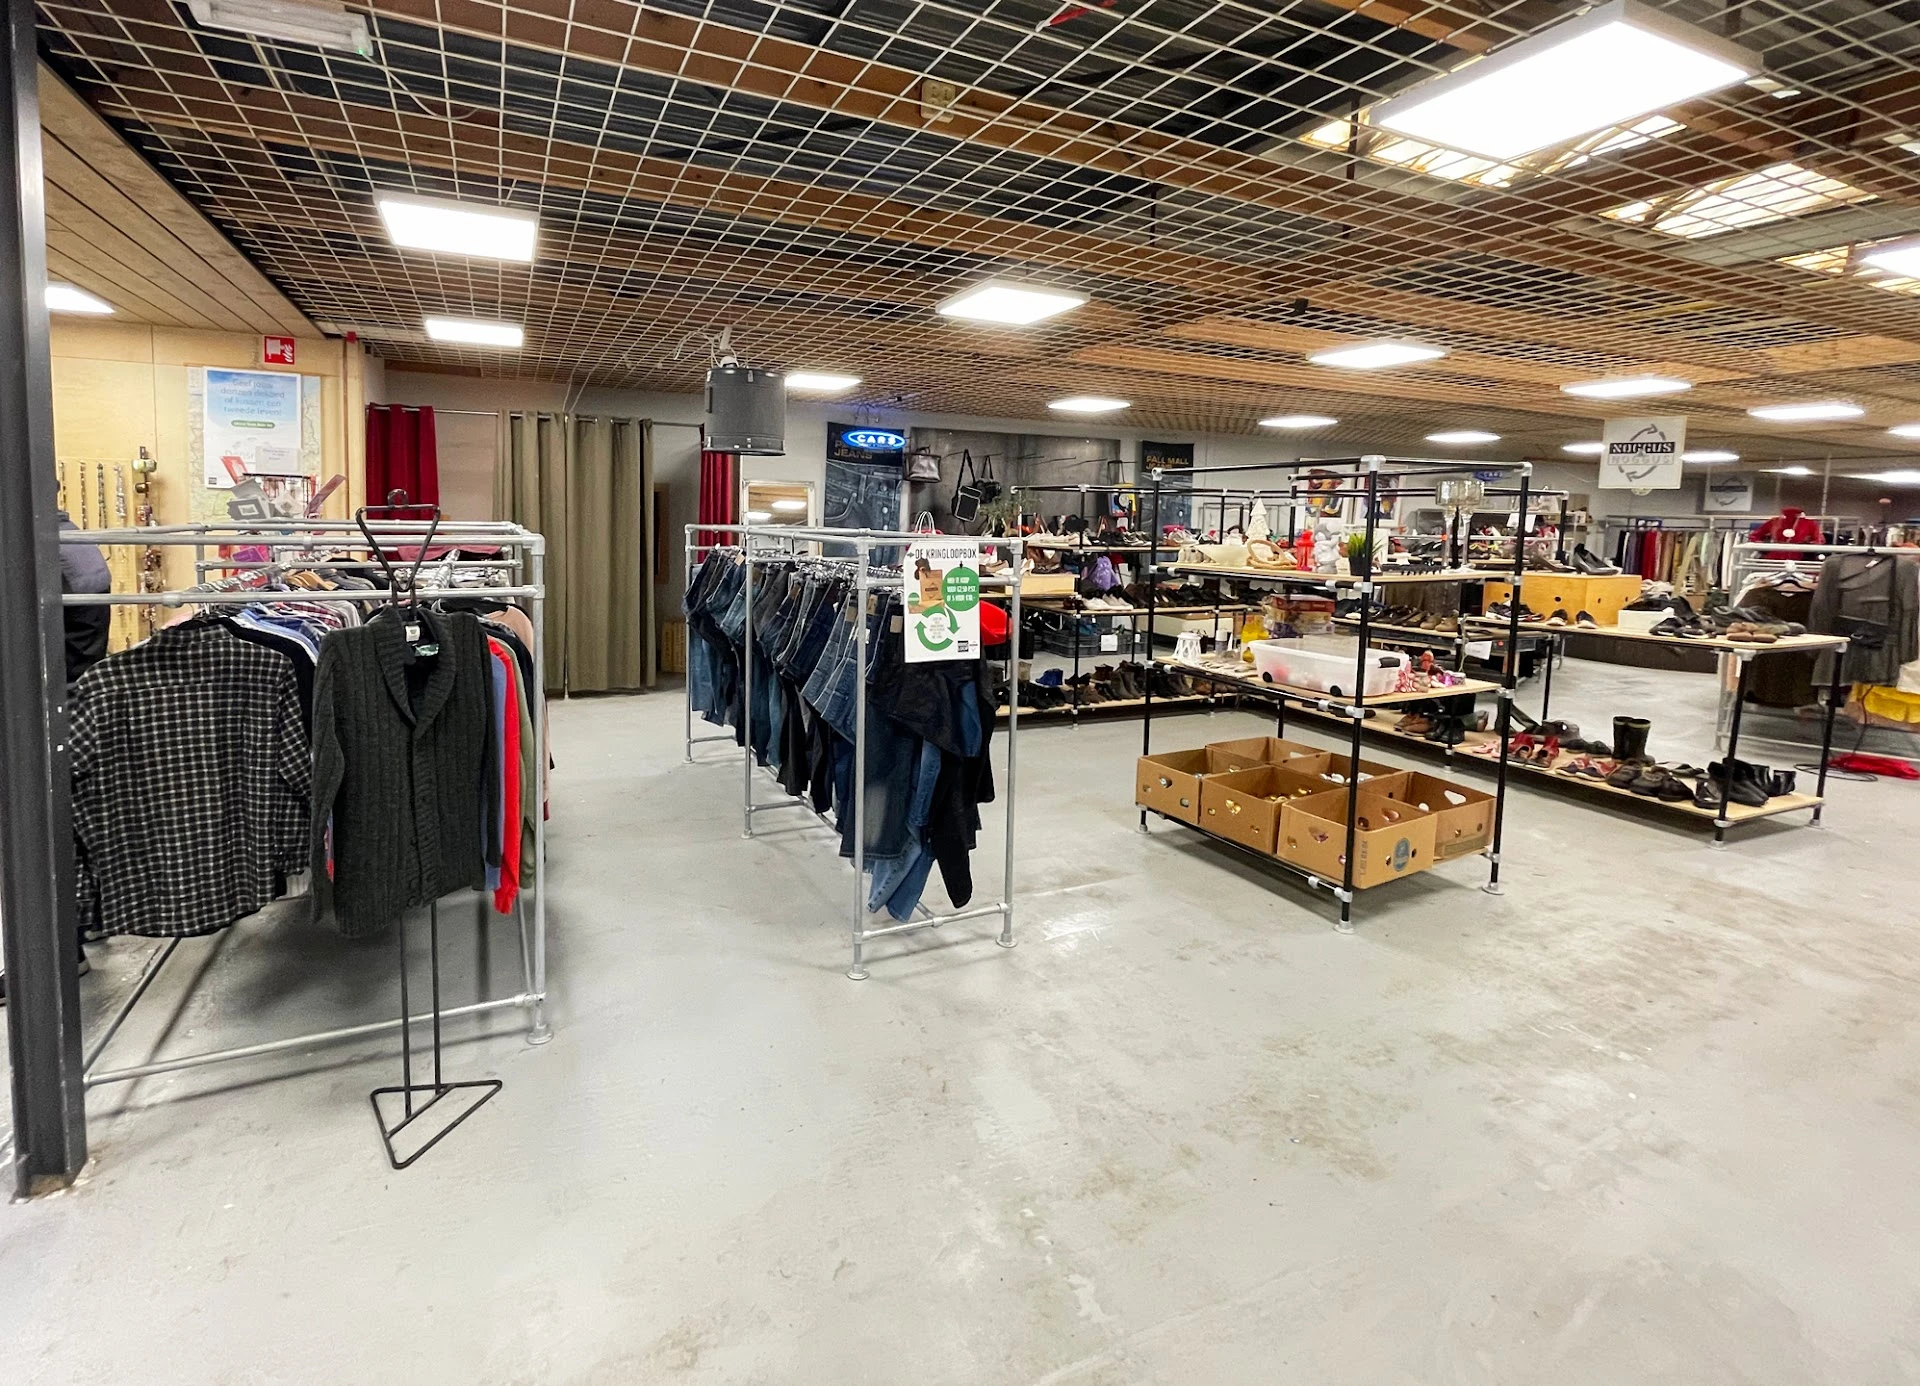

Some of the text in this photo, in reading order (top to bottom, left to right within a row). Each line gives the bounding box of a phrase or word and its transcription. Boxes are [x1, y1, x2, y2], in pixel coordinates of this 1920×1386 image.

[857, 434, 896, 445] CARS
[834, 448, 872, 459] JEANS
[1612, 443, 1672, 453] NOGGUS
[1611, 454, 1671, 464] NOGGUS
[926, 548, 977, 559] KRINGLOOPBOX
